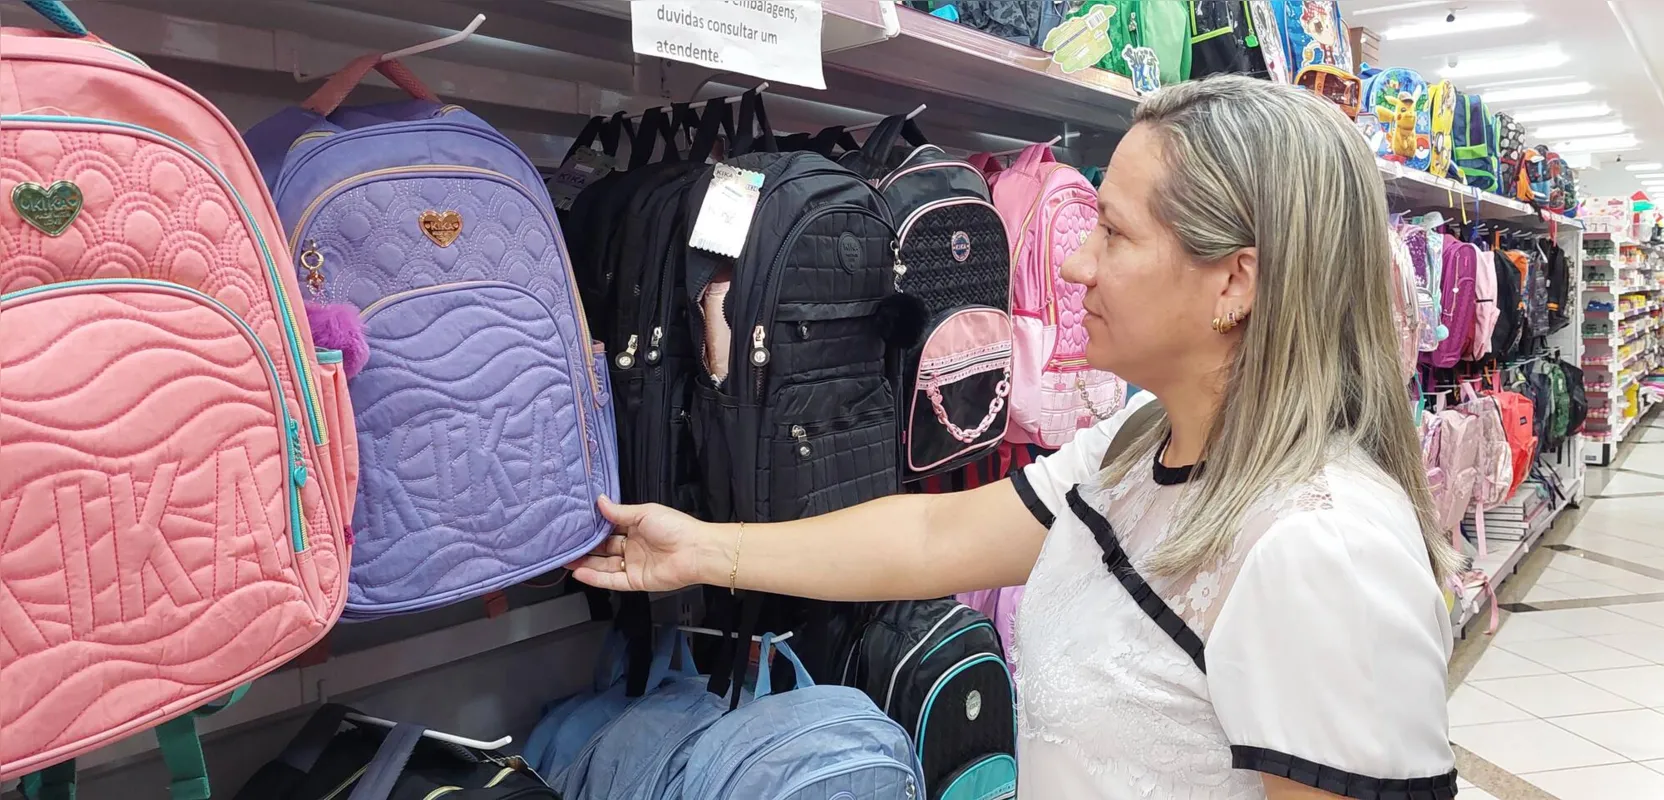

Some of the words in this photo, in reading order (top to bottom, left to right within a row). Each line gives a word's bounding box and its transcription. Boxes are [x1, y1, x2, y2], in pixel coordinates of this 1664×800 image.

[657, 4, 704, 29] duvidas
[707, 18, 758, 40] consultar
[761, 31, 778, 45] um
[656, 40, 724, 63] atendente.
[558, 172, 586, 184] KIKA
[716, 170, 733, 178] KIKA
[430, 221, 454, 230] KIKA
[357, 398, 572, 540] KIKA
